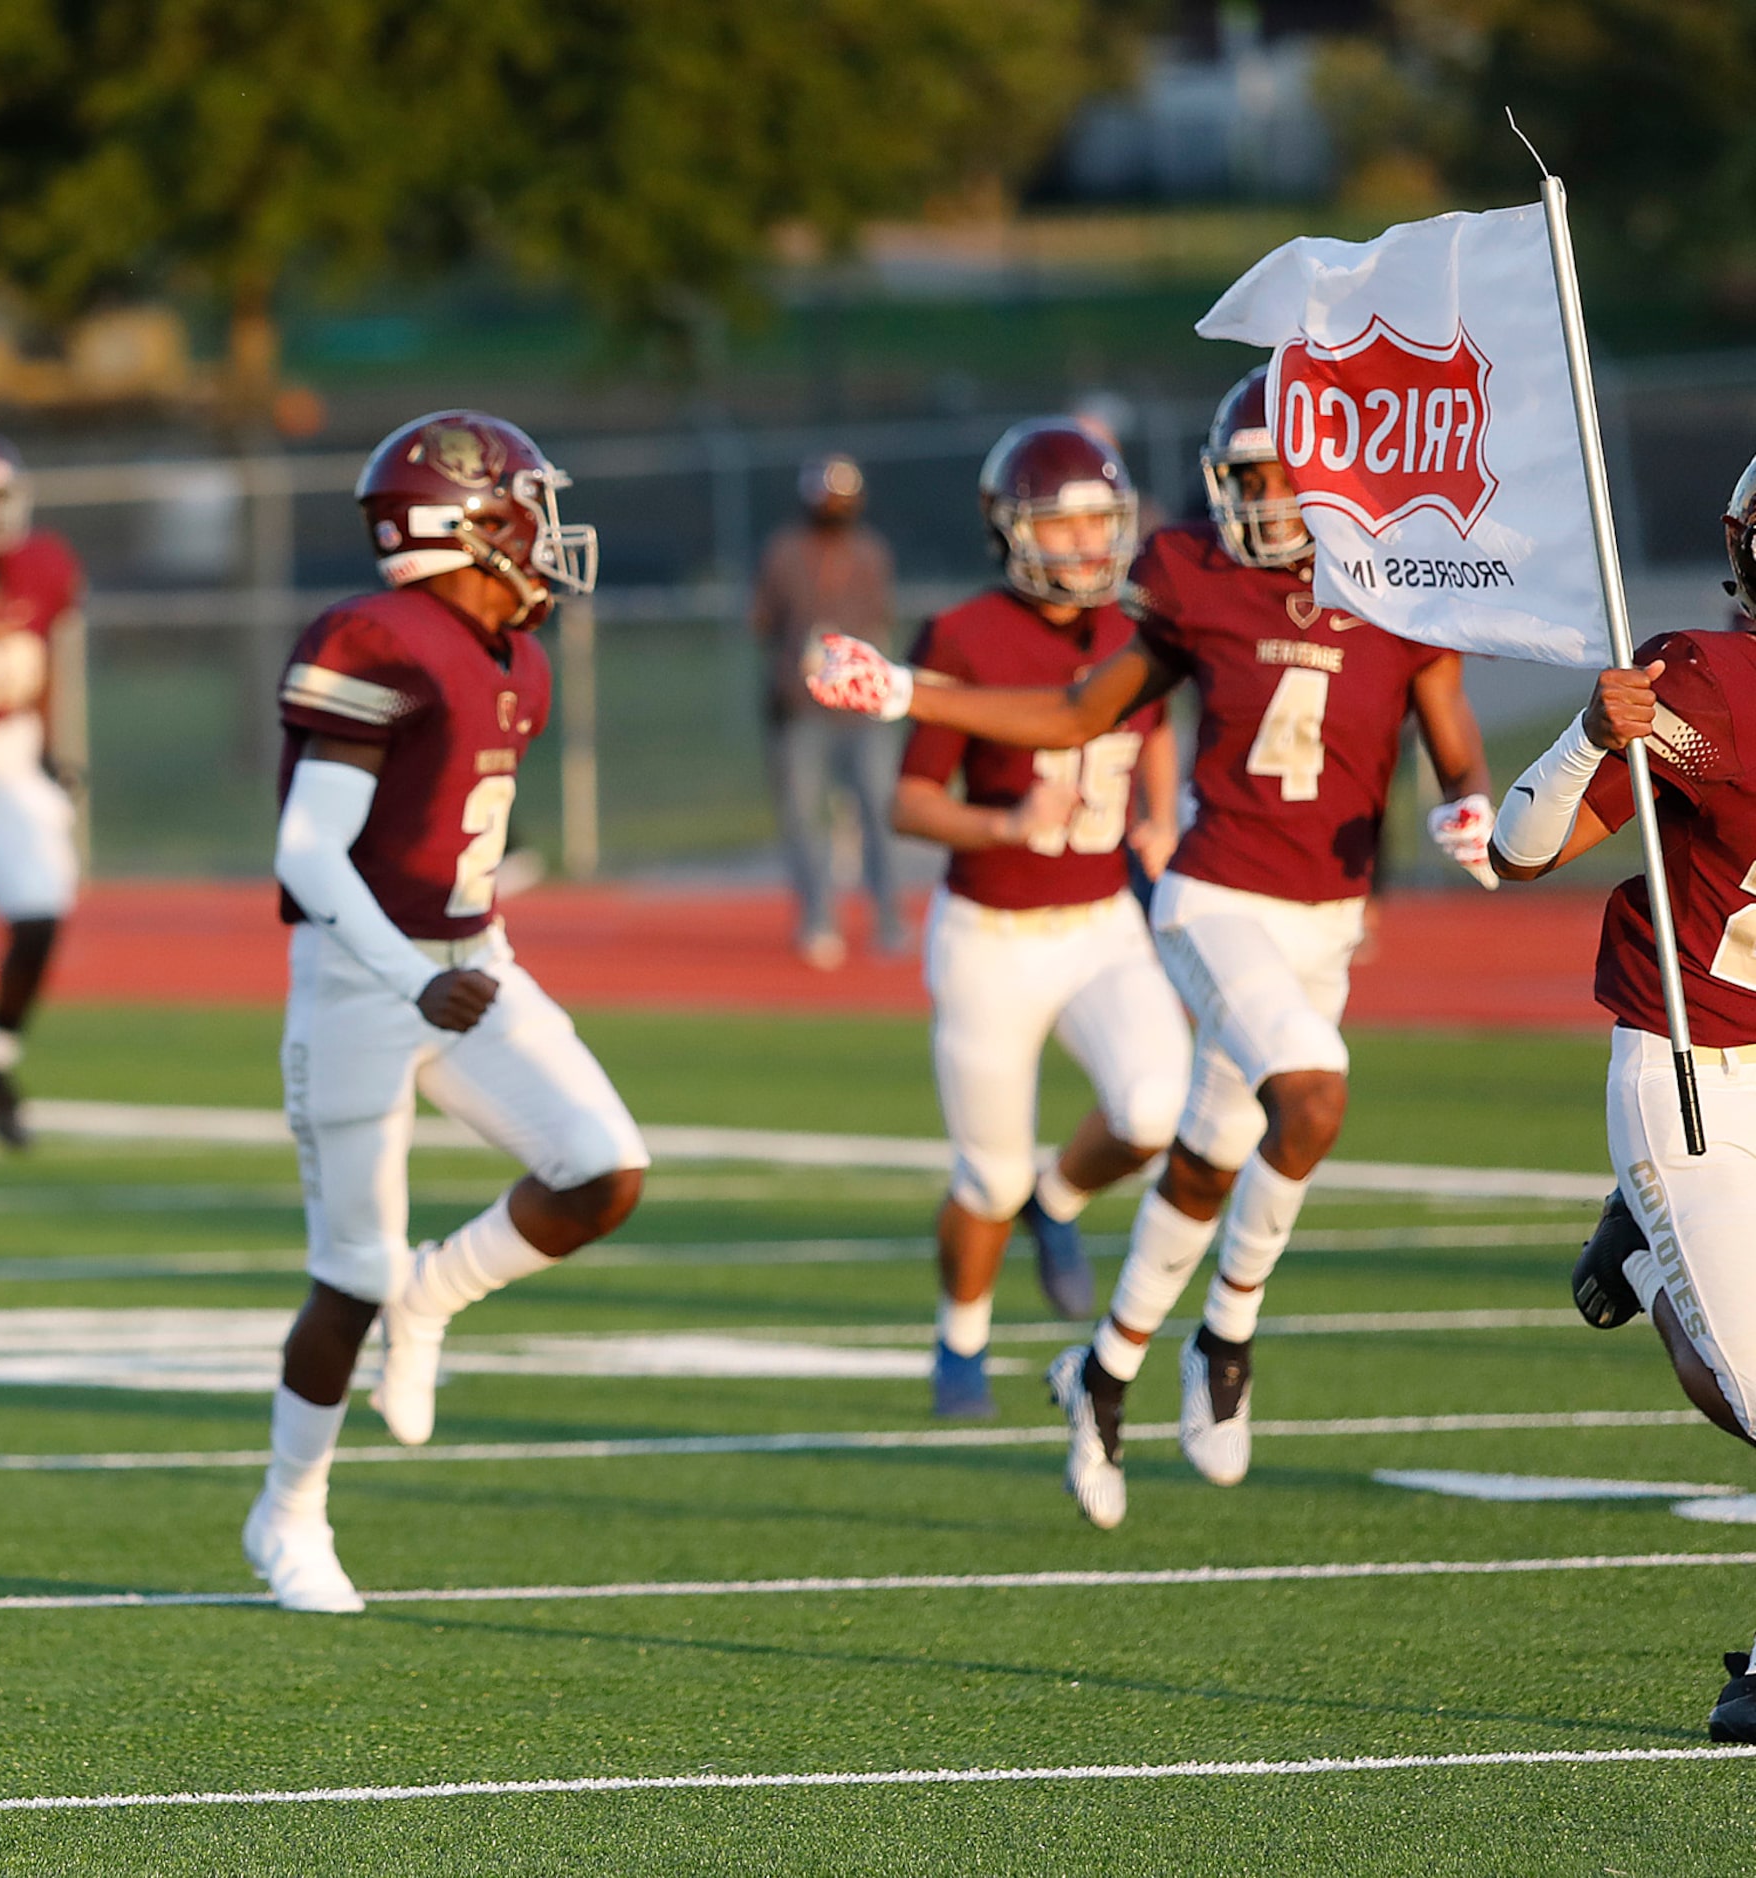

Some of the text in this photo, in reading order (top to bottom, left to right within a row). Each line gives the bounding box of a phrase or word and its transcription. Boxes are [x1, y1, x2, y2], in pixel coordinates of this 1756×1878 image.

[1246, 666, 1329, 802] 4
[444, 774, 517, 919] 2
[1628, 1159, 1708, 1340] COYOTES
